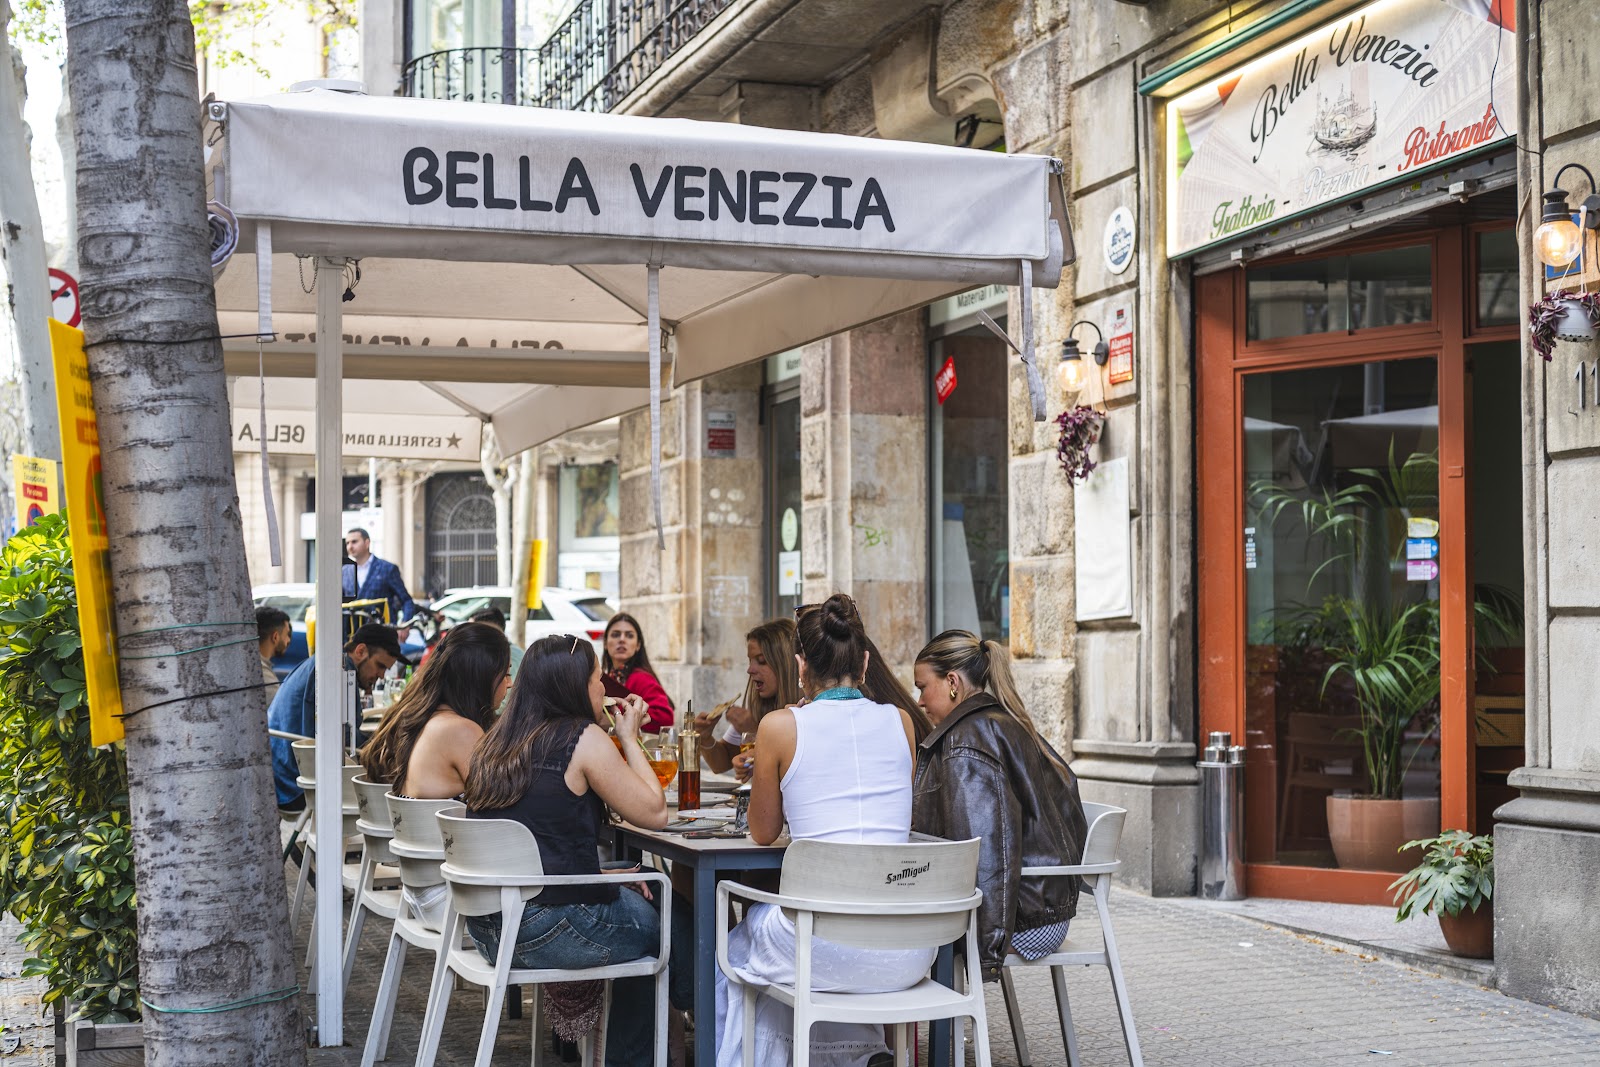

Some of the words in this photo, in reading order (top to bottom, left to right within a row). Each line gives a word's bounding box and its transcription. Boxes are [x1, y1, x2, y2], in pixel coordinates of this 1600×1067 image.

[1250, 47, 1320, 163] Bella
[1329, 15, 1439, 88] Venezia
[402, 146, 601, 216] BELLA
[629, 162, 896, 233] VENEZIA
[1210, 193, 1276, 239] Trattoria
[1302, 161, 1369, 205] Pizzeria
[1397, 102, 1498, 172] Ristorante
[957, 290, 986, 308] Material
